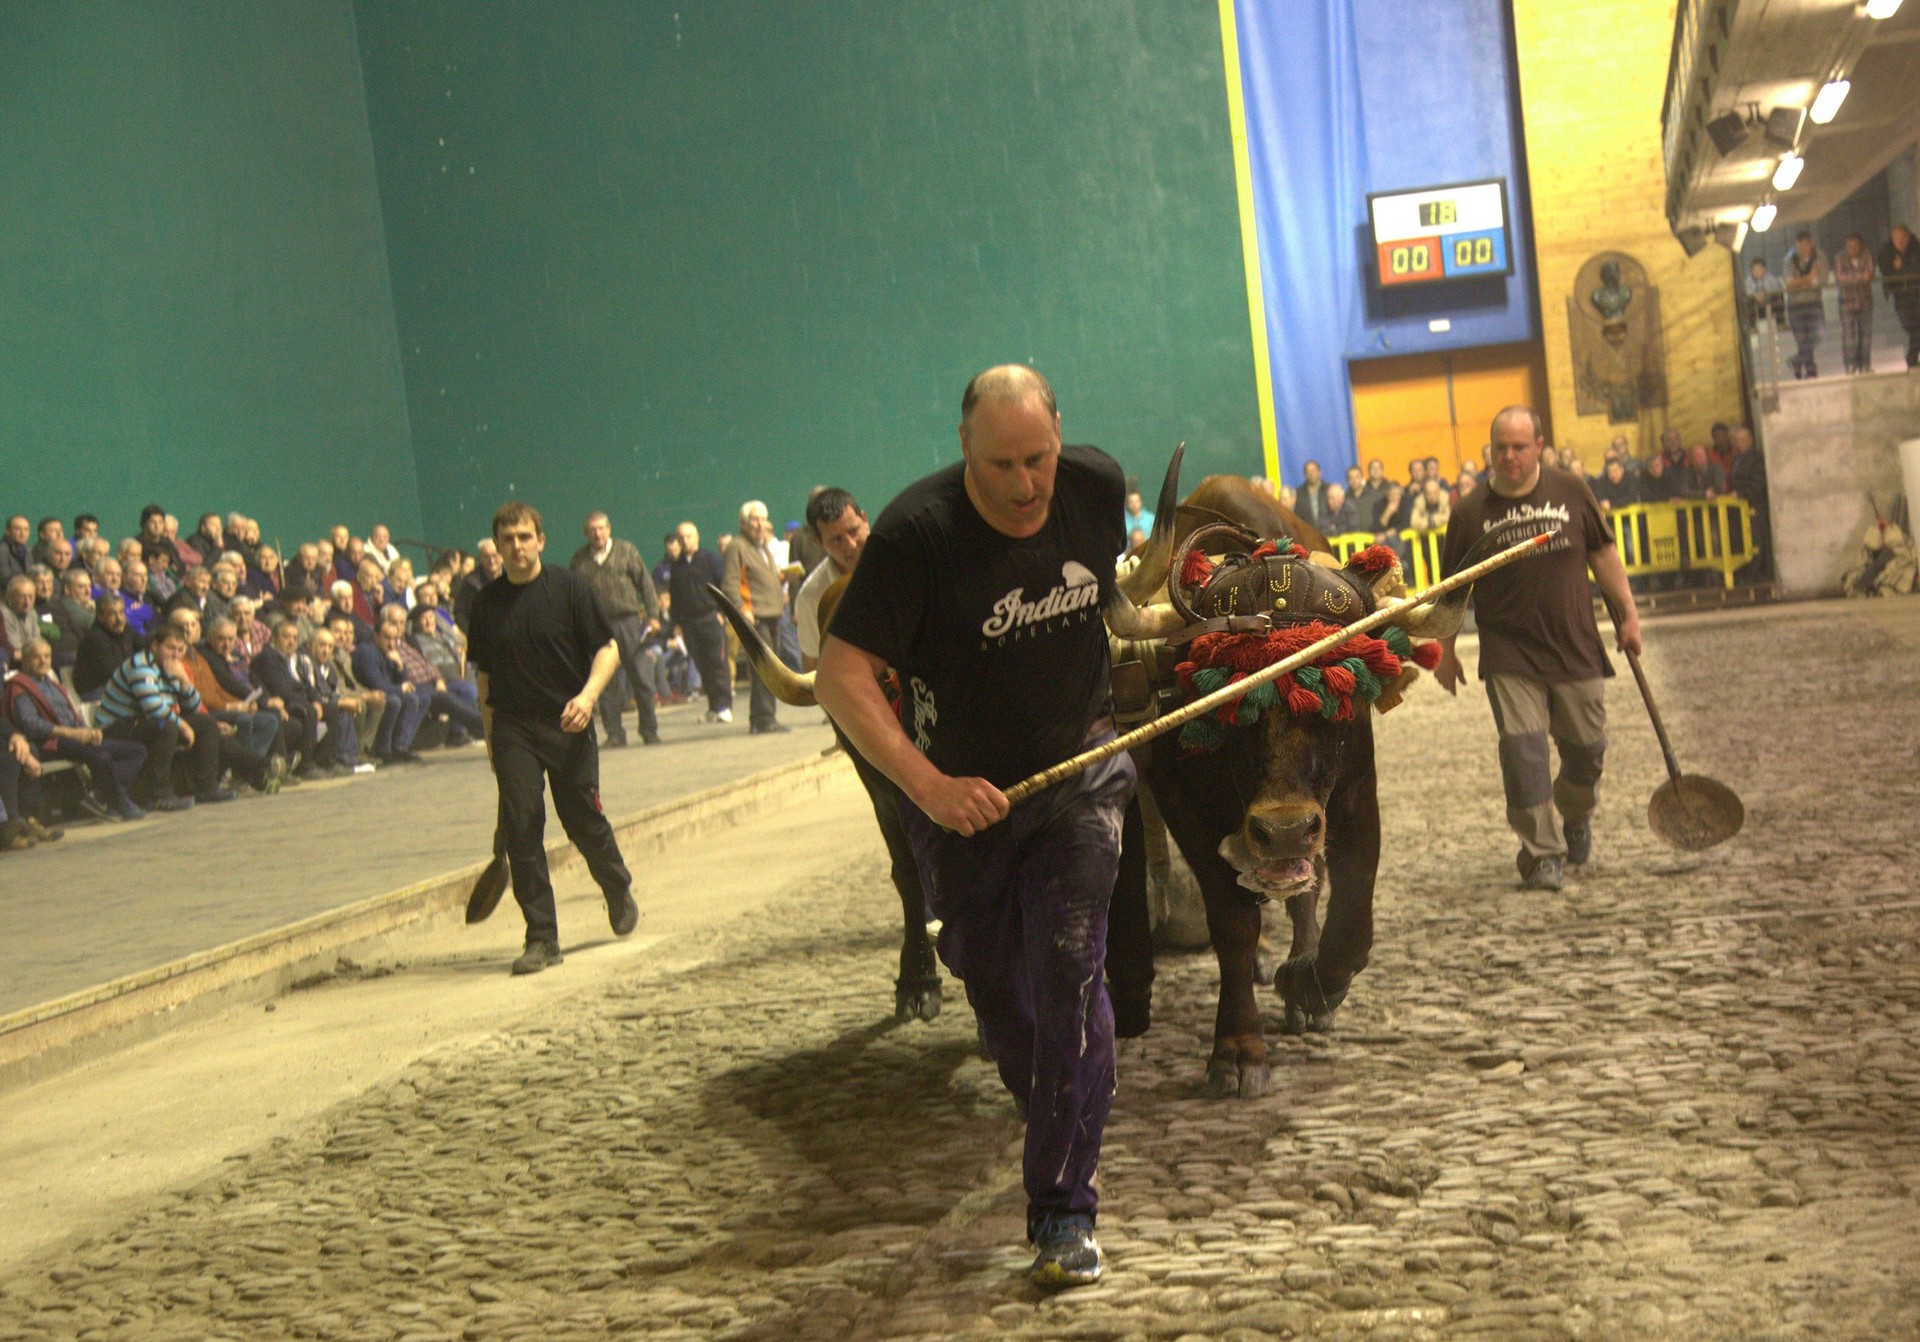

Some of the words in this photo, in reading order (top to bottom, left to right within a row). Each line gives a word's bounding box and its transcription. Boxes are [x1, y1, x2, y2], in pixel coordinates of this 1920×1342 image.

[1392, 245, 1428, 274] 00
[1456, 238, 1491, 266] 00
[1520, 500, 1570, 523] Dakota
[982, 583, 1099, 638] Indian
